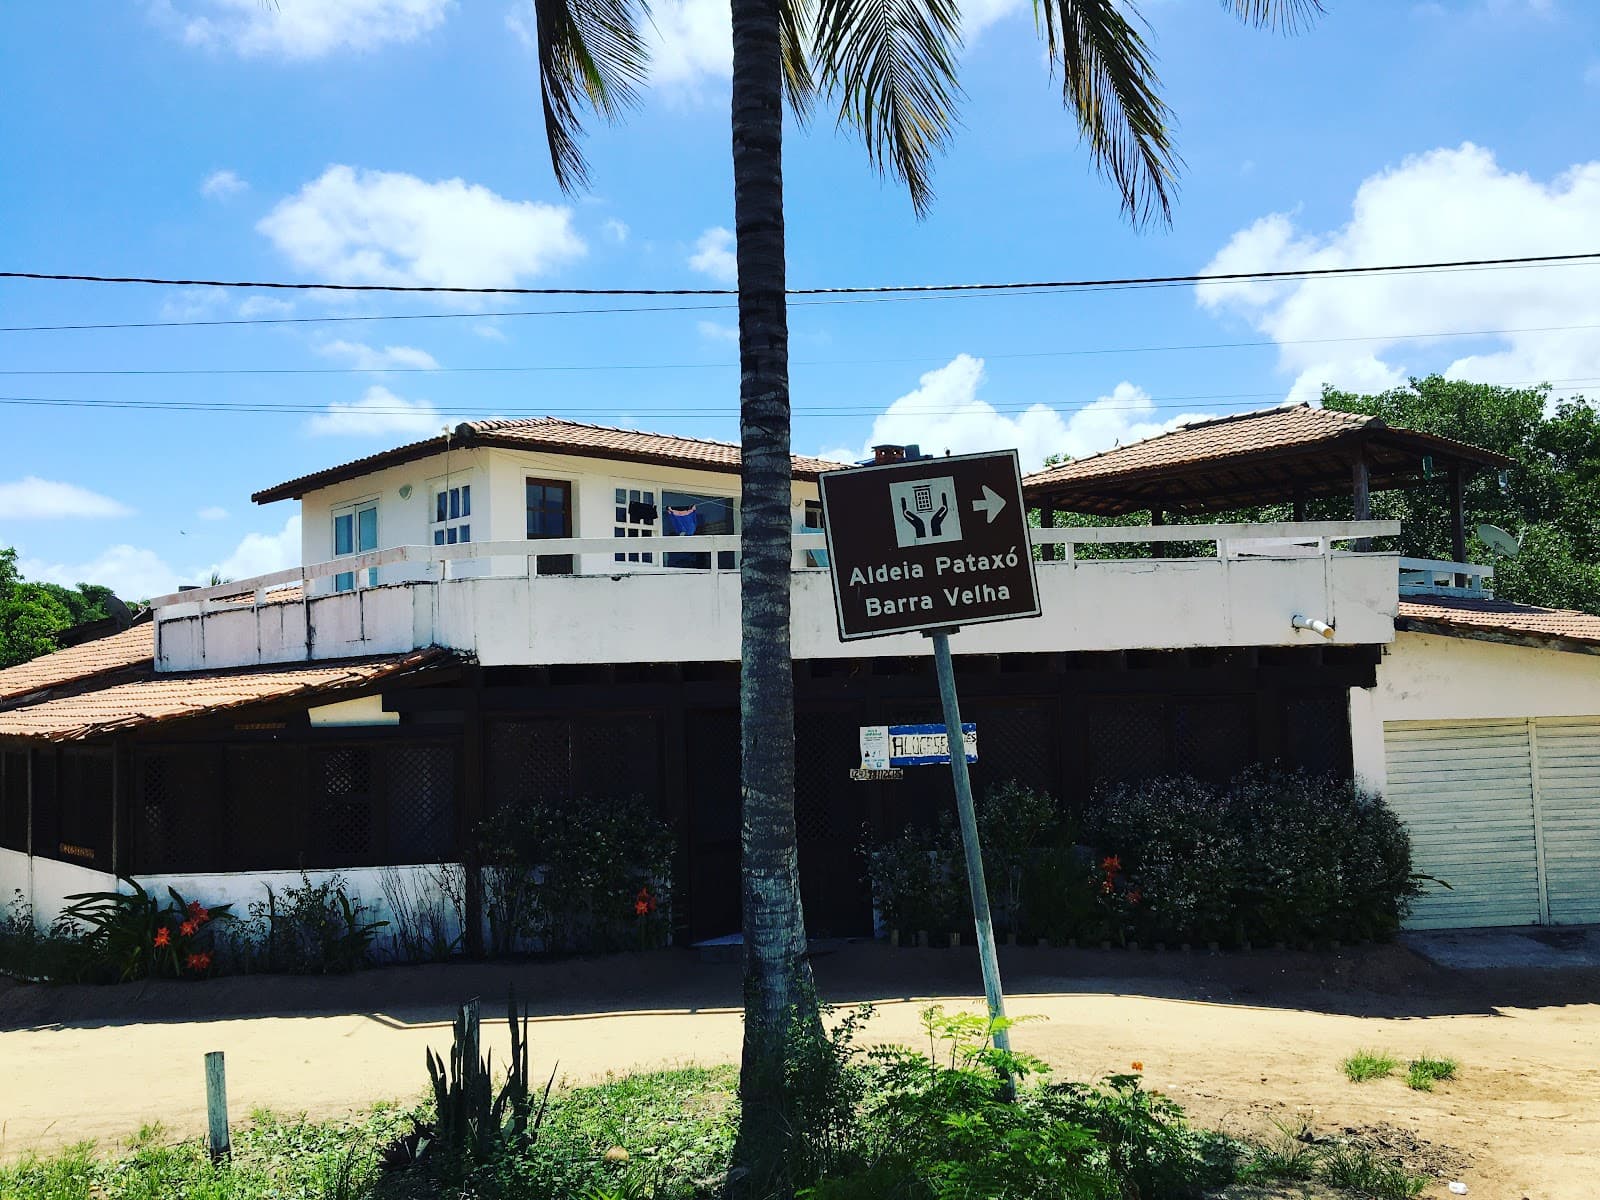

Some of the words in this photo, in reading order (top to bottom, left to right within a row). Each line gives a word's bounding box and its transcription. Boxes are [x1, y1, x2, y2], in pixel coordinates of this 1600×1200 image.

[849, 561, 924, 586] Aldeia
[935, 546, 1018, 575] Pataxó
[865, 595, 933, 617] Barra
[943, 584, 1010, 606] Velha
